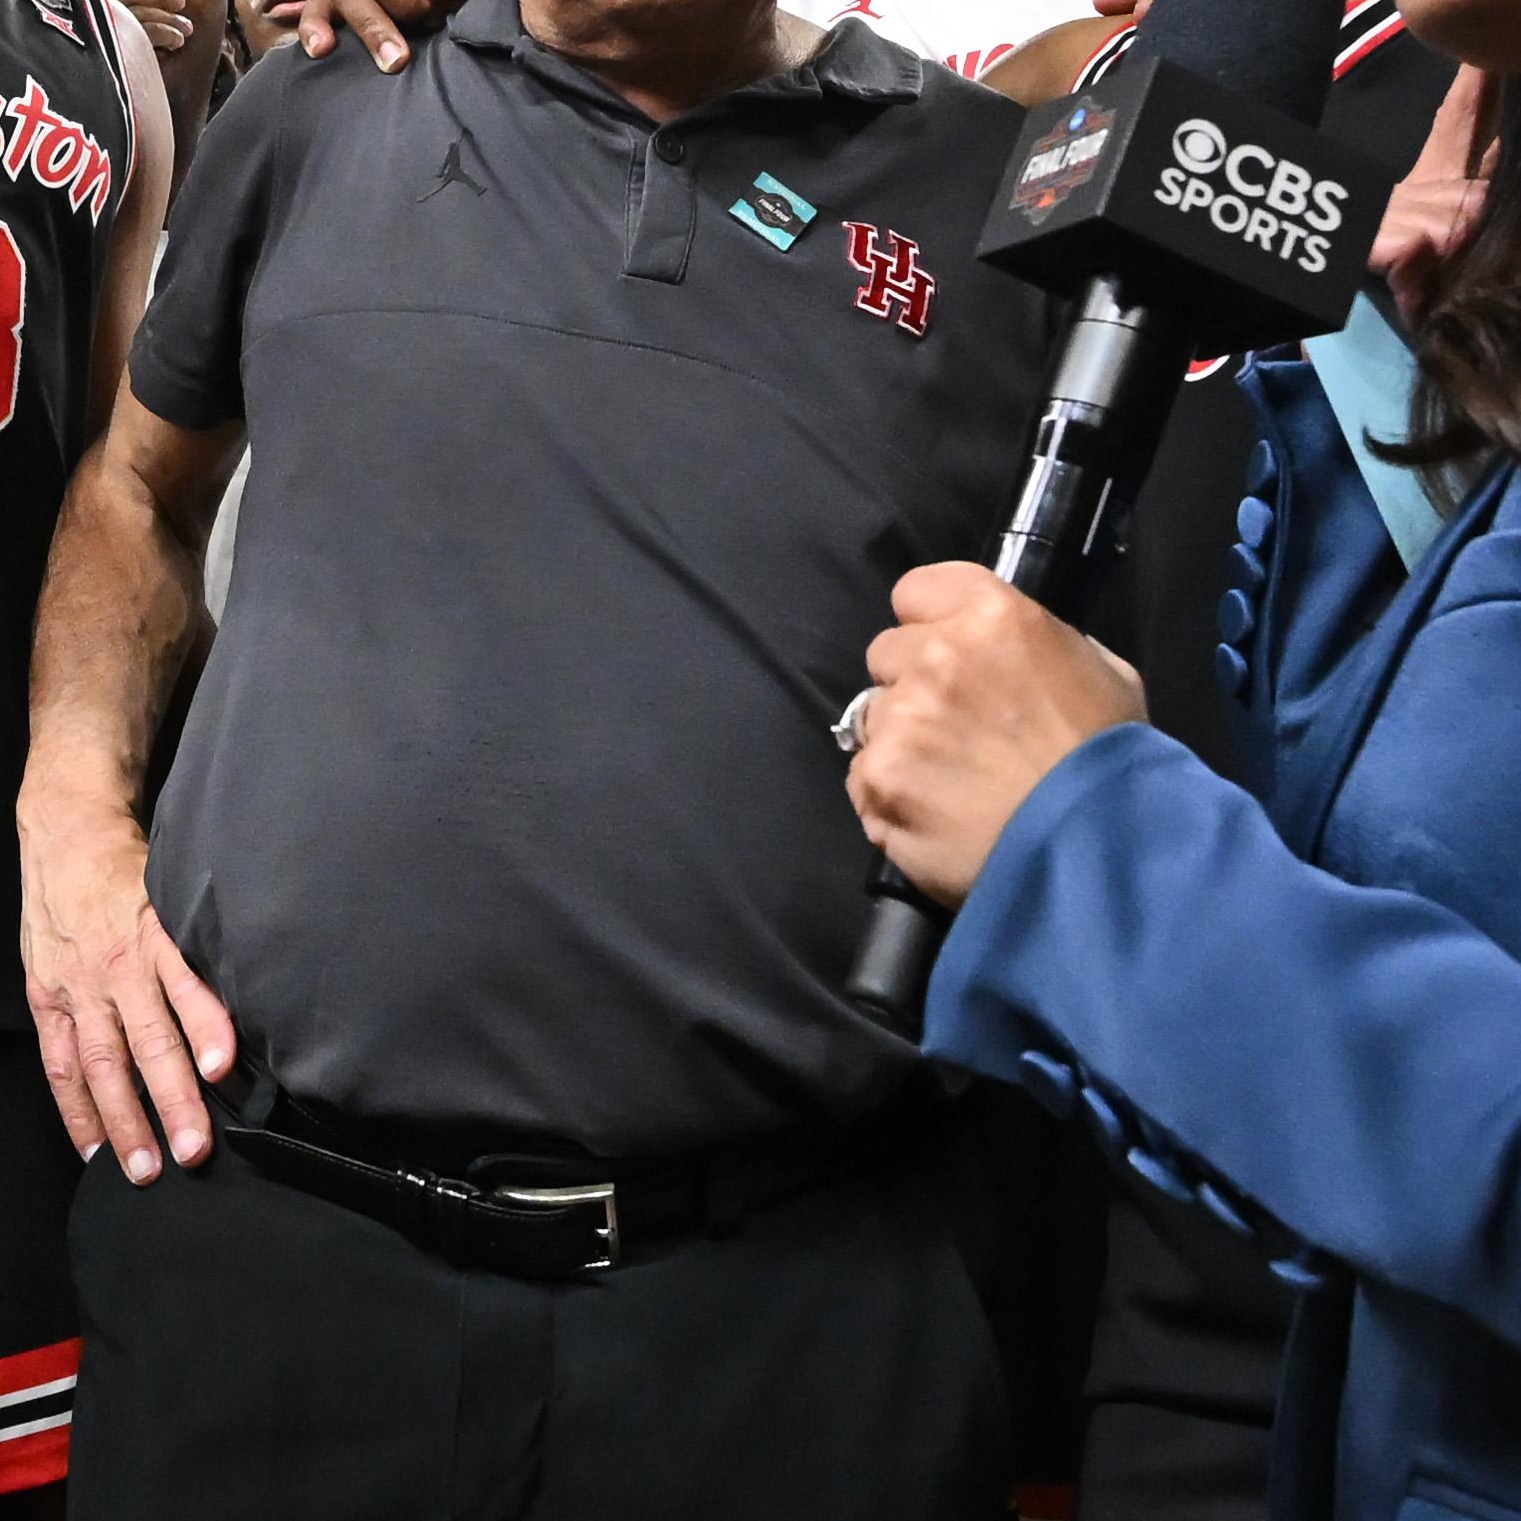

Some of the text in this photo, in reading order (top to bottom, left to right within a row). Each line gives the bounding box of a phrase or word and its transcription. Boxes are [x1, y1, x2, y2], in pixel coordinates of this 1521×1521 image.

[1153, 167, 1332, 273] SPORTS
[1225, 144, 1349, 232] CBS
[840, 220, 936, 336] UH
